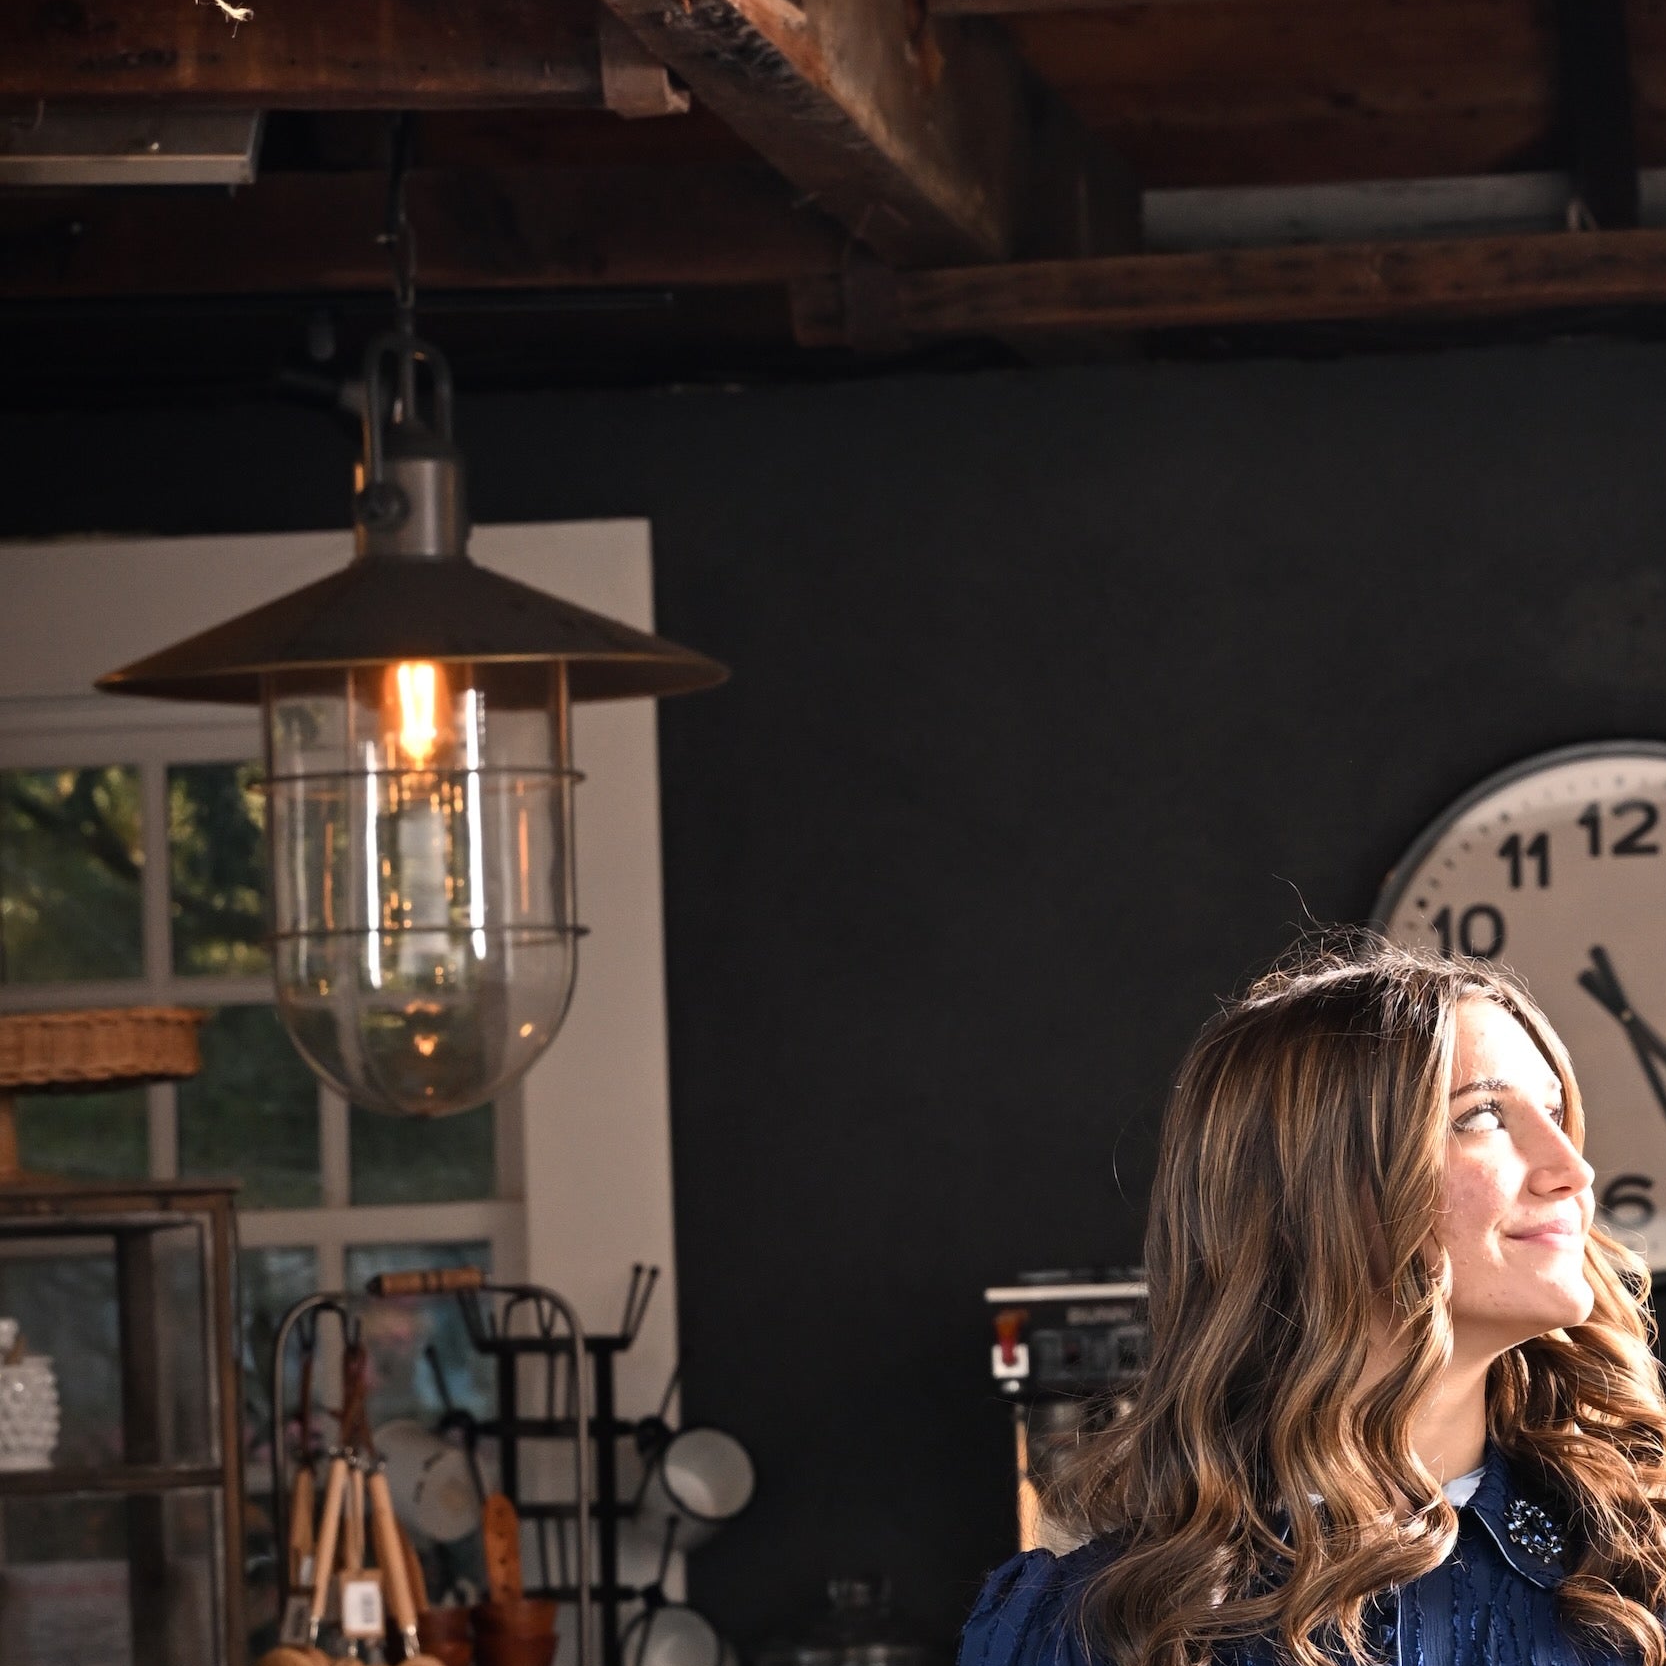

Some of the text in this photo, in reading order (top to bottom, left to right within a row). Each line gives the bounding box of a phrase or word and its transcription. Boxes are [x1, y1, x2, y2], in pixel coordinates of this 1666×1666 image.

[1577, 799, 1660, 857] 12
[1498, 831, 1551, 889] 11
[1430, 902, 1505, 961] 10
[1602, 1173, 1655, 1227] 6
